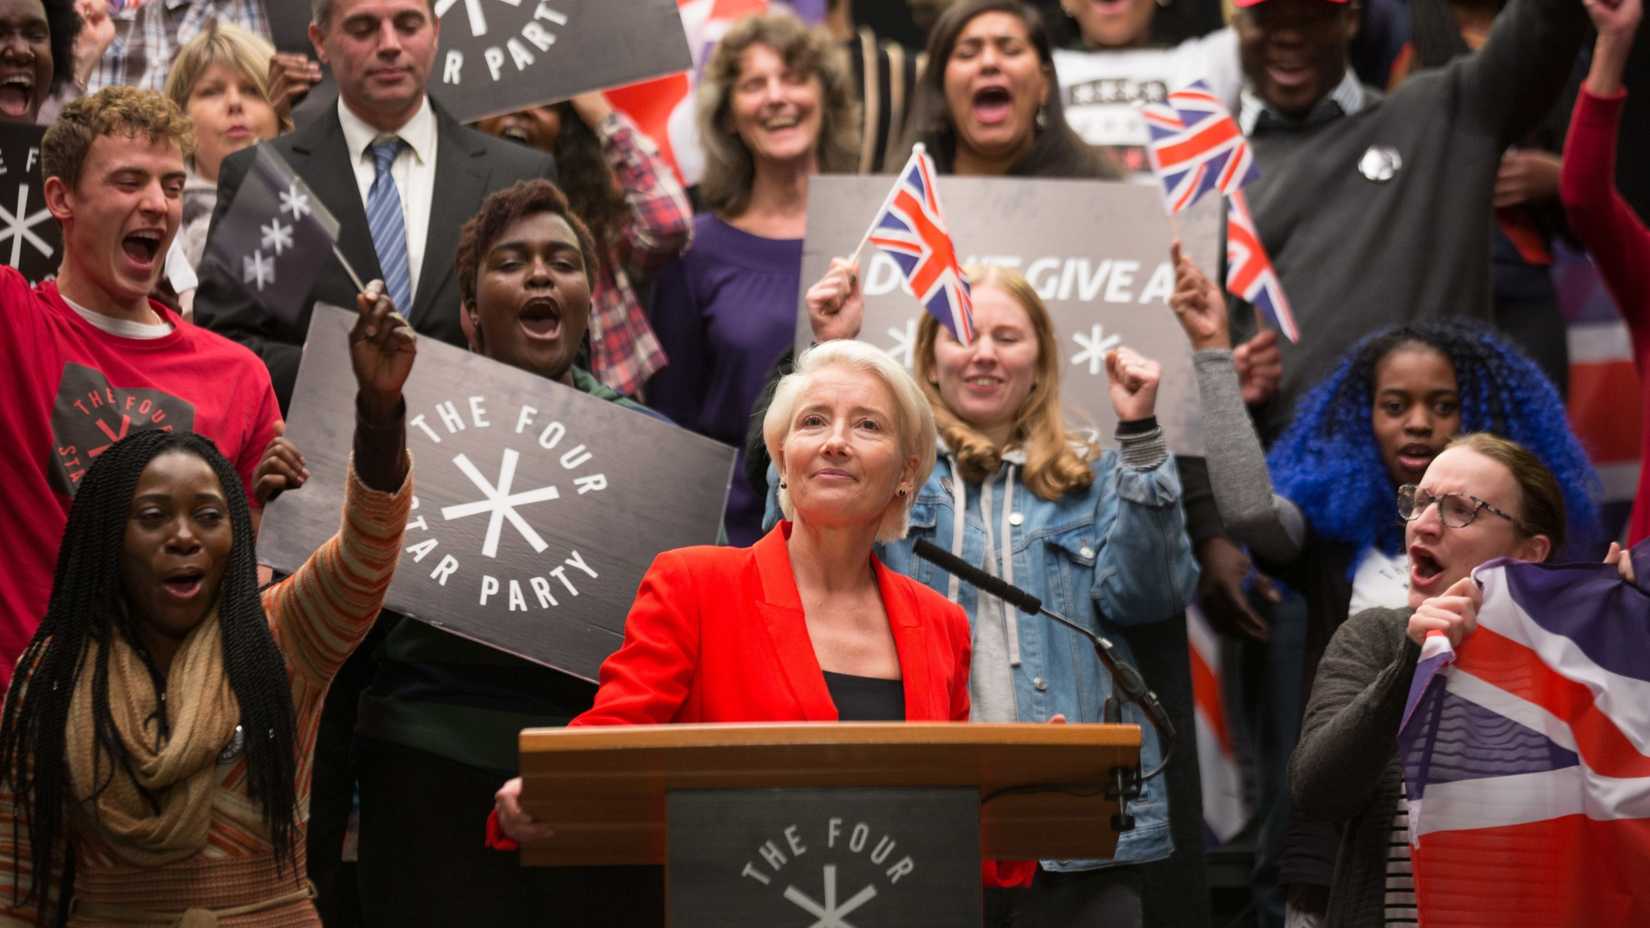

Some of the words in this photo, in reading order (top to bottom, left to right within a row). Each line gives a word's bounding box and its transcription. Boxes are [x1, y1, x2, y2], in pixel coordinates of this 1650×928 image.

[484, 0, 567, 82] PART
[1023, 256, 1139, 303] GIVE
[73, 387, 116, 416] THE
[410, 396, 490, 443] THE
[515, 405, 608, 495] FOUR
[479, 550, 599, 612] PARTY
[741, 824, 807, 885] THE
[827, 817, 914, 885] FOUR
